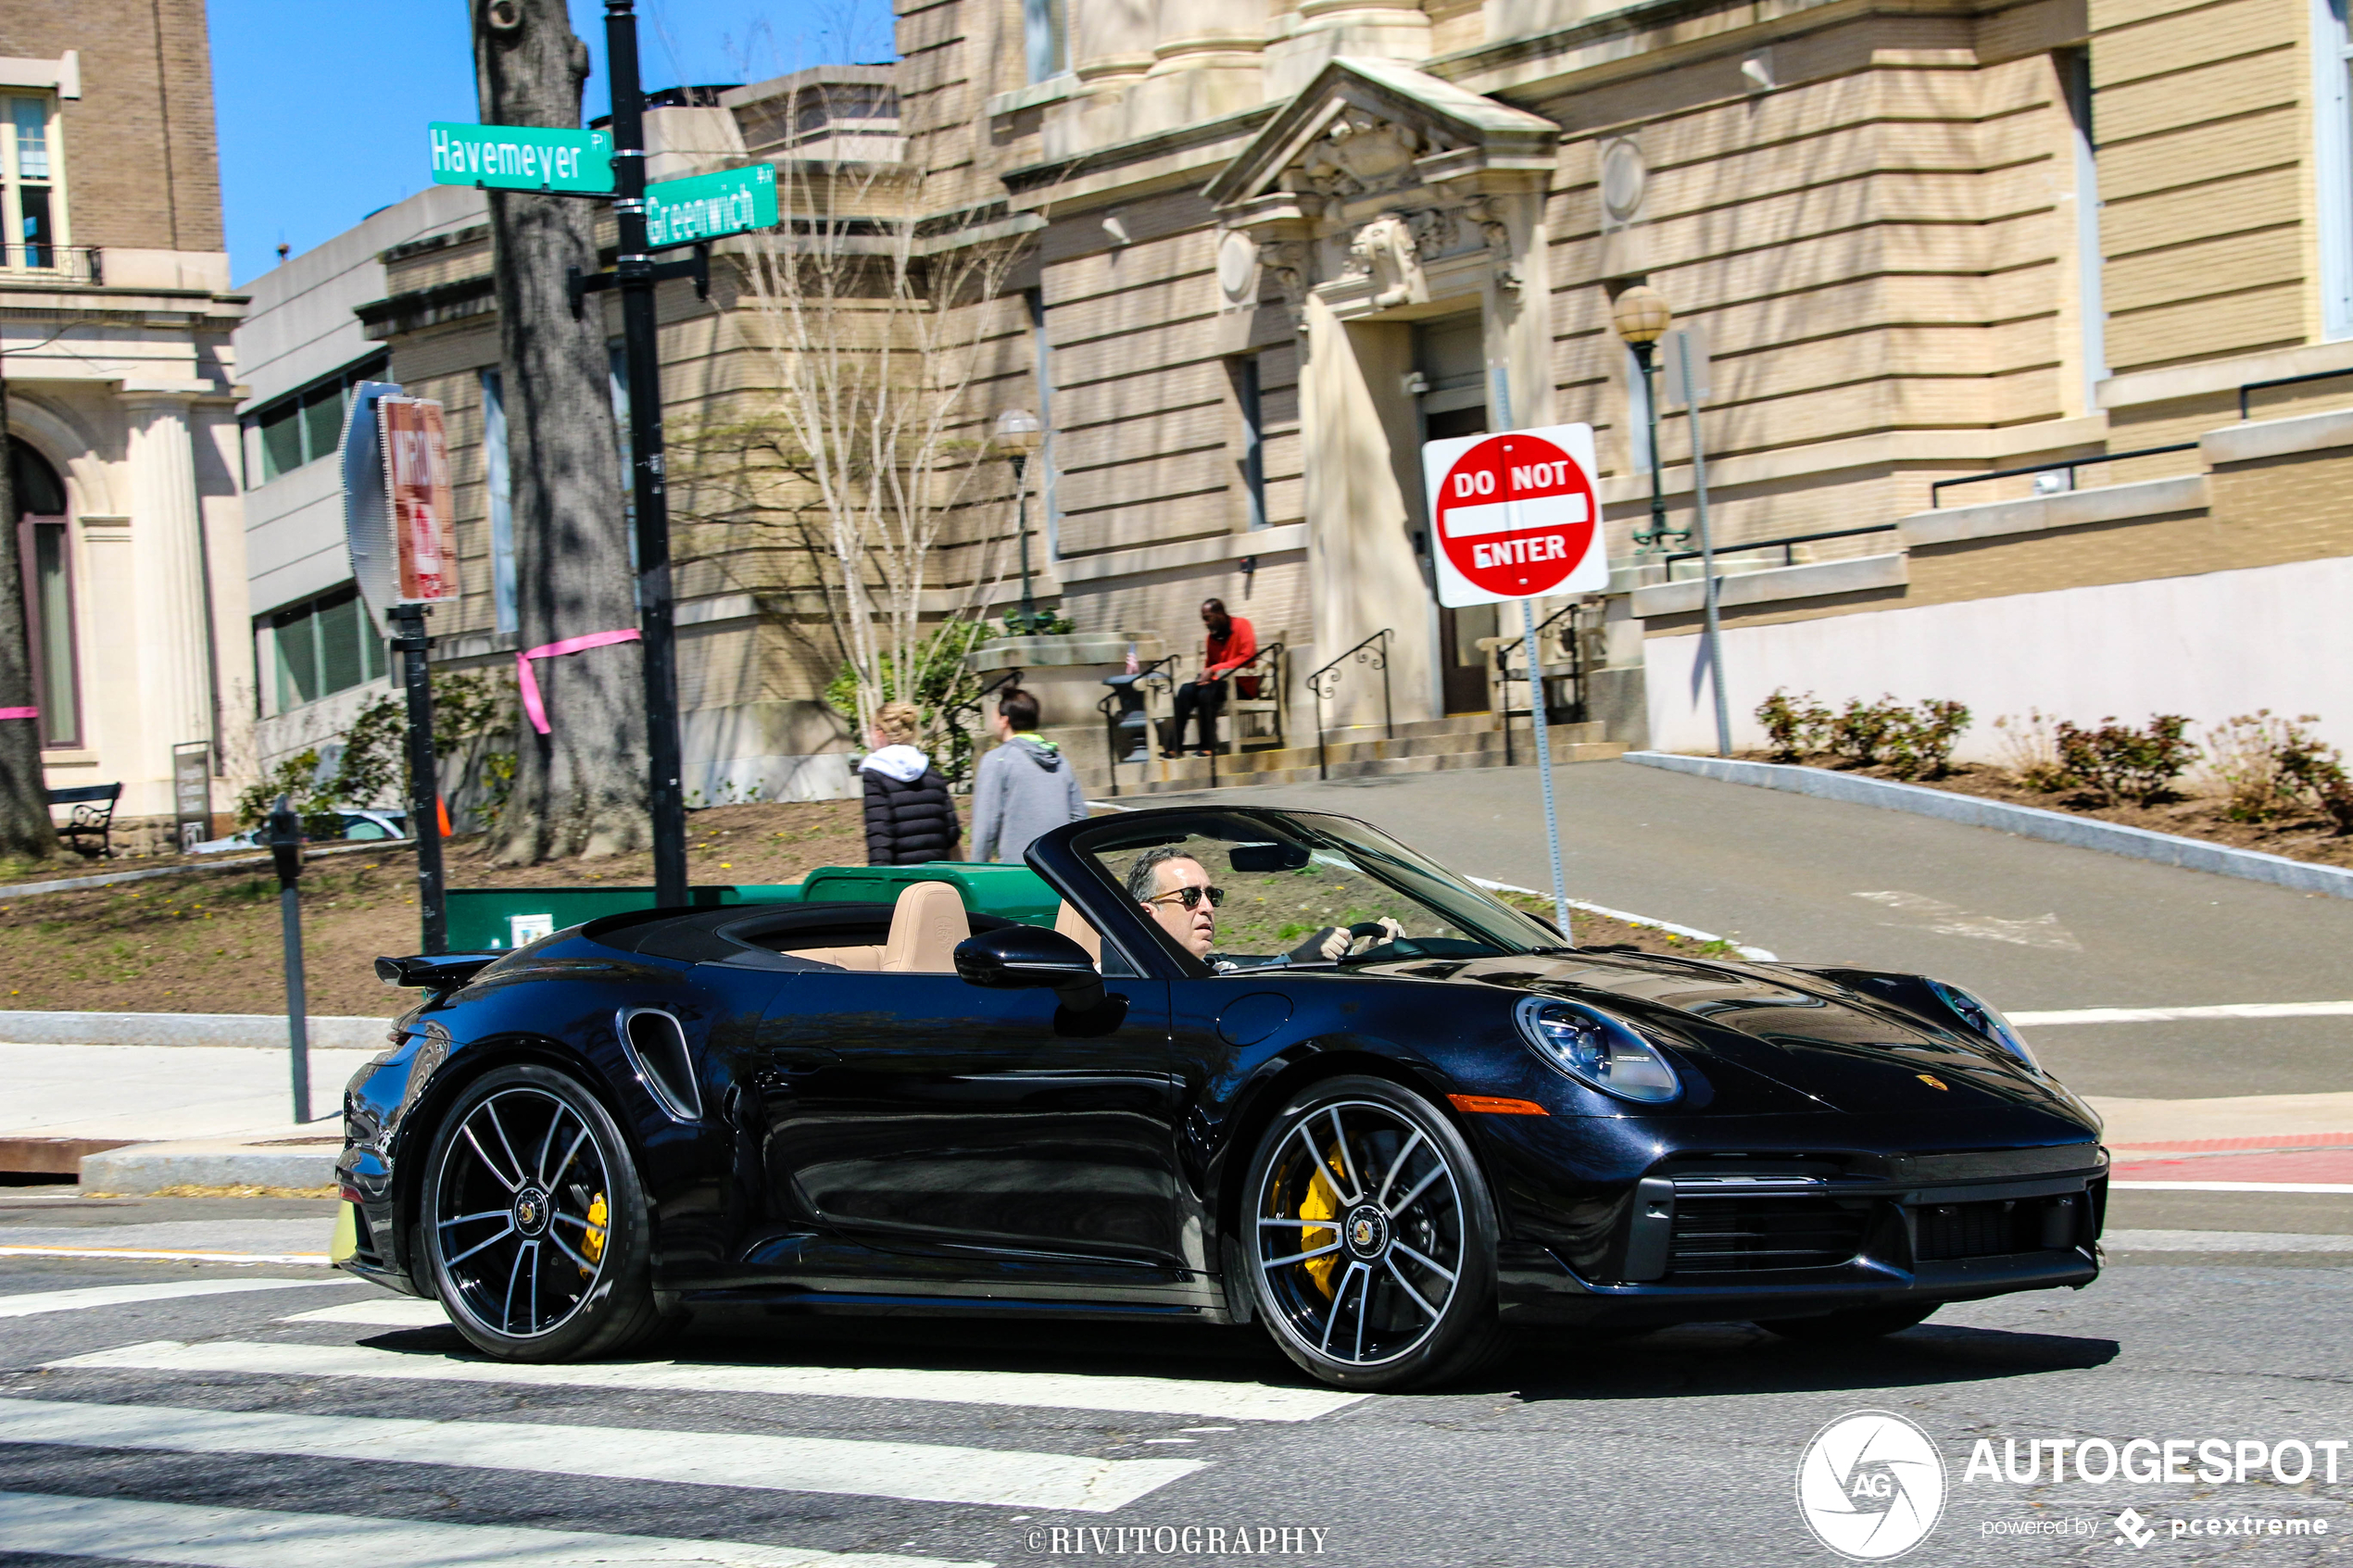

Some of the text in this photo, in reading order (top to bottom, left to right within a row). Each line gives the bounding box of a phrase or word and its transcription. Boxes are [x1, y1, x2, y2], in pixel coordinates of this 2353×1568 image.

[430, 129, 582, 183] Havemeyer
[646, 182, 755, 244] Greenwich
[1453, 460, 1569, 497] DO NOT
[1472, 534, 1567, 569] ENTER
